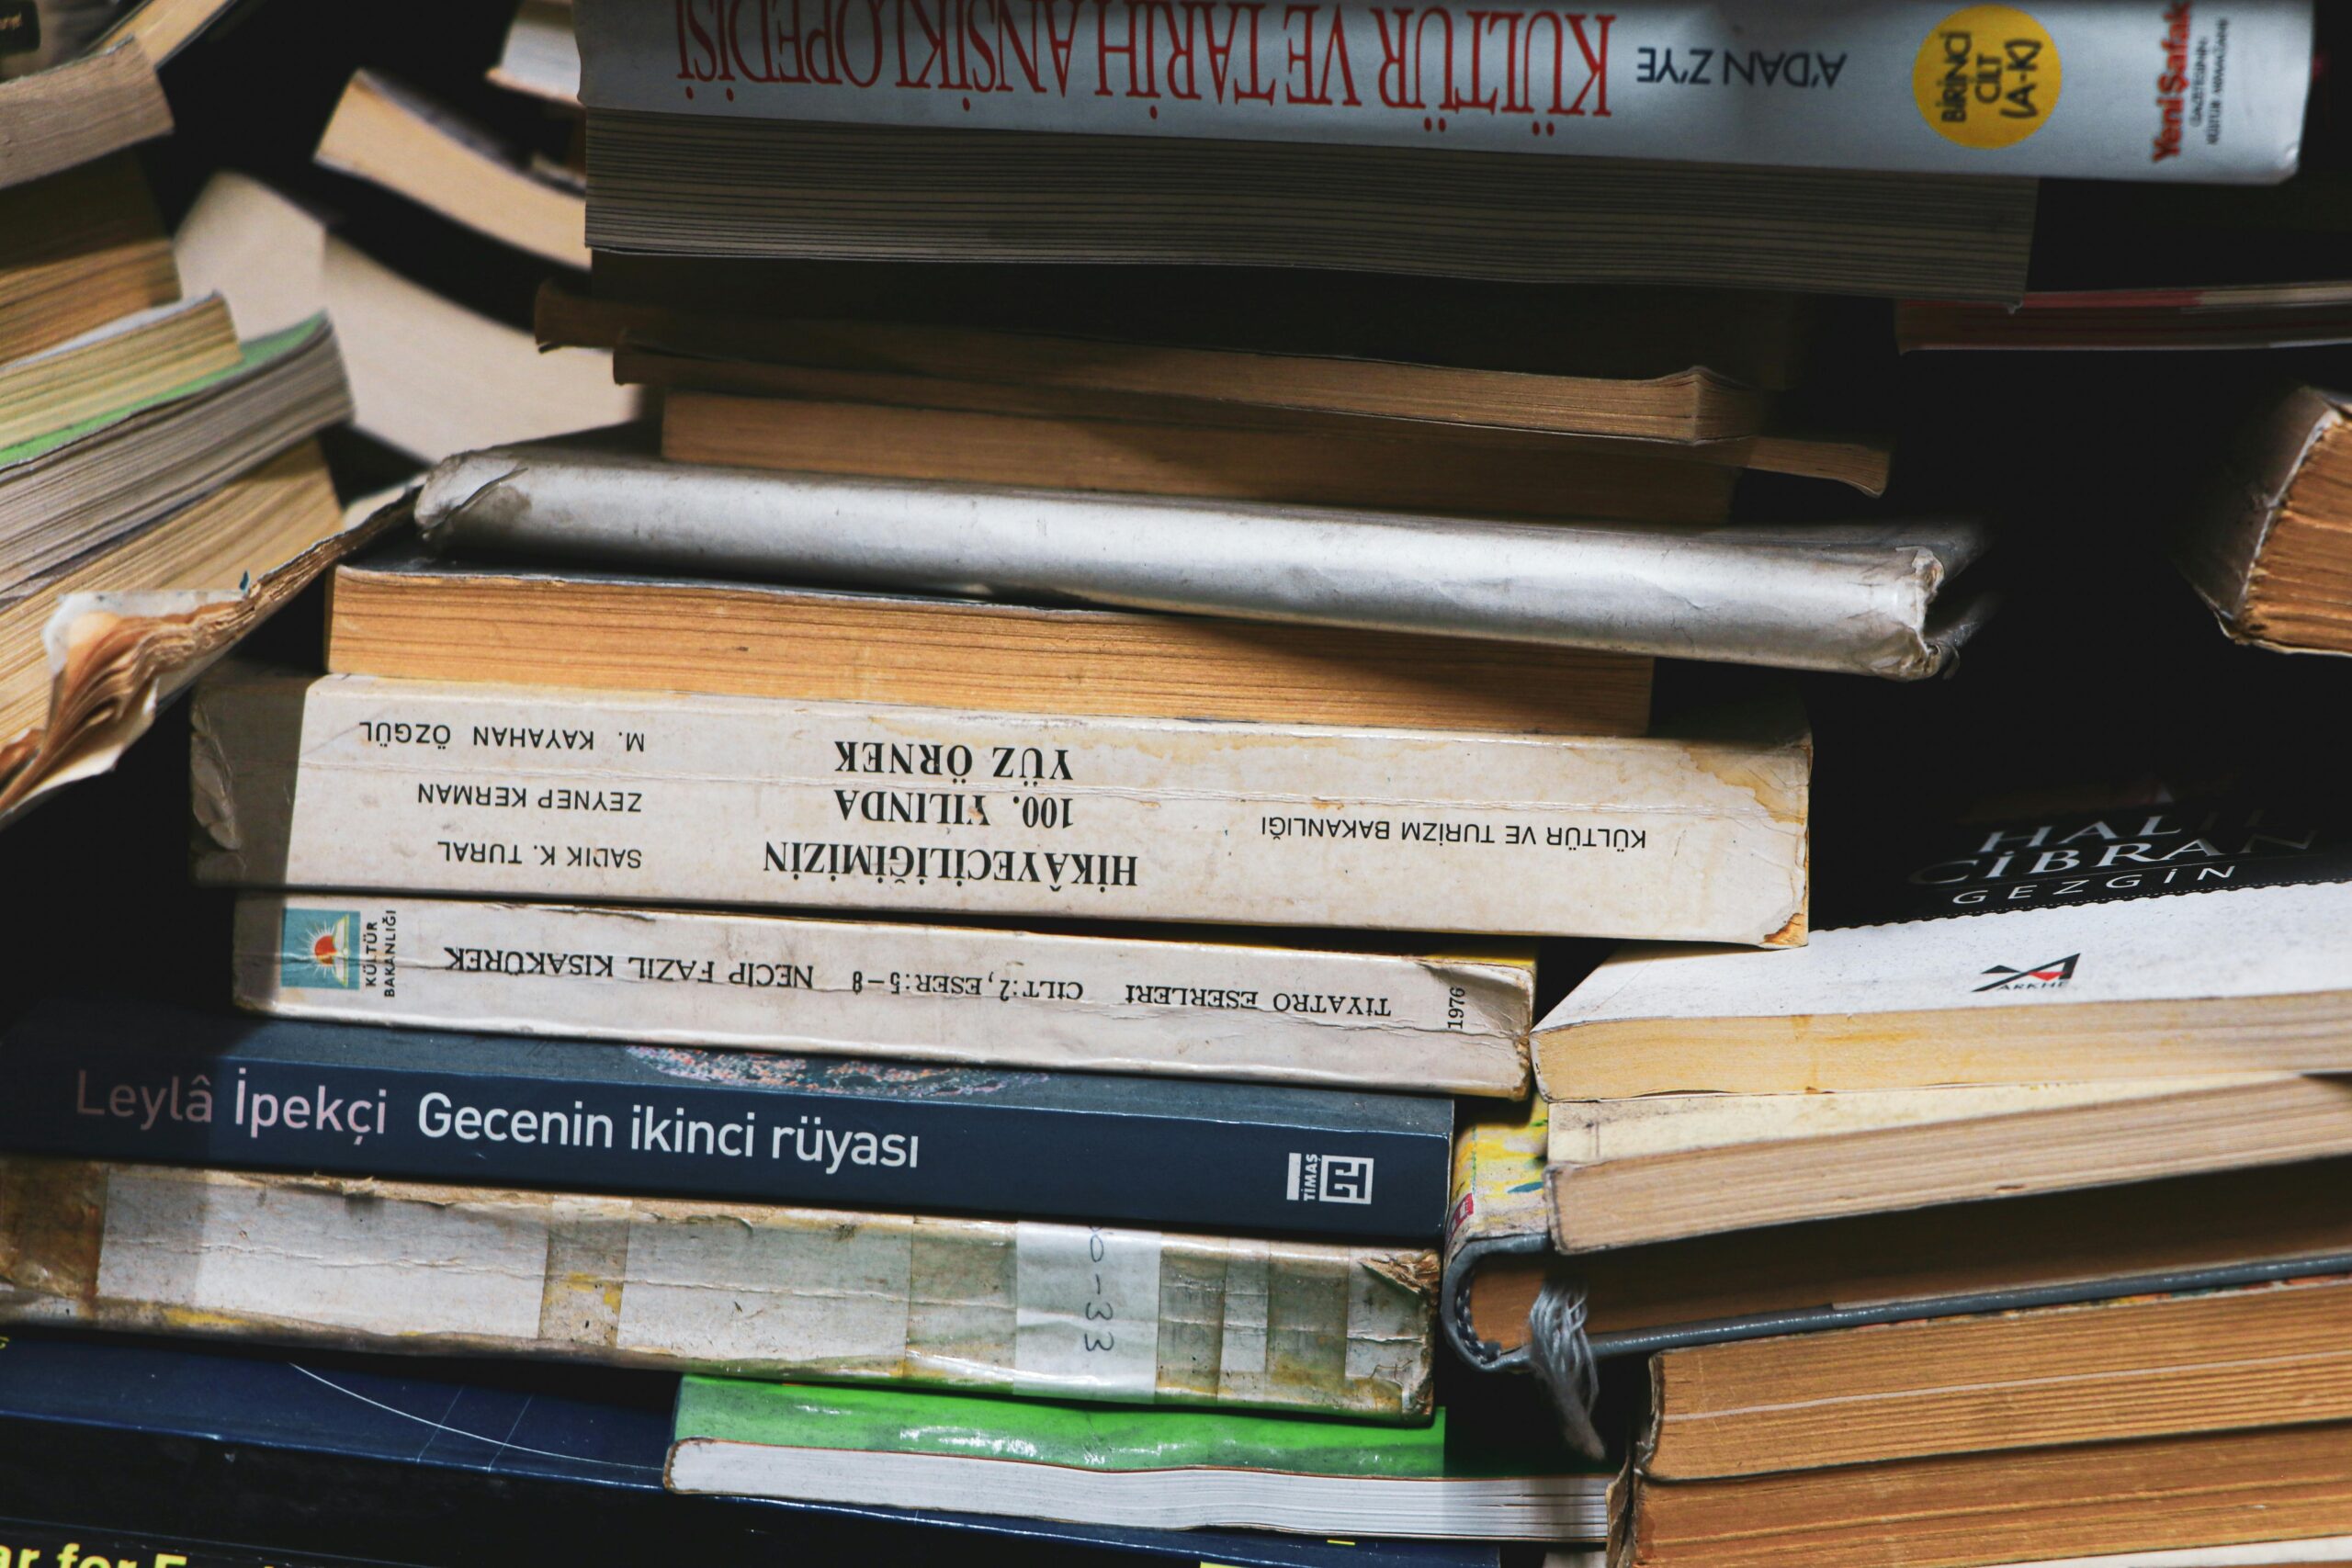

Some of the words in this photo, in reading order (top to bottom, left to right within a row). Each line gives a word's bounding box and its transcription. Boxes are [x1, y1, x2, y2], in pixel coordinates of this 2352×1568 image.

[1094, 0, 1276, 119] TARİH
[1283, 3, 1362, 107] VE
[1369, 6, 1616, 136] KÜLTÜR
[1636, 48, 1713, 85] Z'YE
[1723, 51, 1848, 88] A'DAN
[2000, 39, 2042, 118] (A-K)
[2152, 98, 2185, 162] Yeni
[359, 721, 451, 750] ÖZGÜL
[472, 726, 594, 750] KAYAHAN
[618, 731, 645, 752] M.
[833, 740, 974, 784] ÖRNEK
[991, 747, 1074, 787] YÜZ
[418, 783, 526, 807] KERMAN
[537, 788, 643, 813] ZEYNEP
[833, 789, 991, 826] YILINDA
[1012, 795, 1074, 829] 100.
[1261, 816, 1390, 840] BAKANLIĞI
[1401, 821, 1495, 847] TURİZM
[1505, 825, 1537, 846] VE
[1546, 827, 1647, 852] KÜLTÜR
[437, 840, 523, 865] TURAL
[533, 843, 556, 866] K.
[567, 845, 642, 869] SADIK
[763, 840, 1139, 894] HİKÂYECİLİĞİMİZİN
[1907, 830, 2318, 886] CİBRAN
[1952, 865, 2236, 905] GEZGİN
[363, 921, 378, 987] KÜLTÜR
[382, 909, 396, 998] BAKANLIĞI
[443, 946, 614, 977] KISAKÜREK
[628, 955, 716, 984] FAZIL
[728, 962, 814, 989] NECİP
[1125, 984, 1259, 1010] ESERLERİ
[1273, 993, 1392, 1017] TİYATRO
[1447, 987, 1465, 1029] 1976
[76, 1069, 212, 1131] Leylâ
[234, 1067, 387, 1145] İpekçi
[418, 1092, 613, 1149] Gecenin
[631, 1104, 755, 1157] ikinci
[773, 1116, 919, 1174] rüyası
[1302, 1154, 1321, 1201] TİMAŞ
